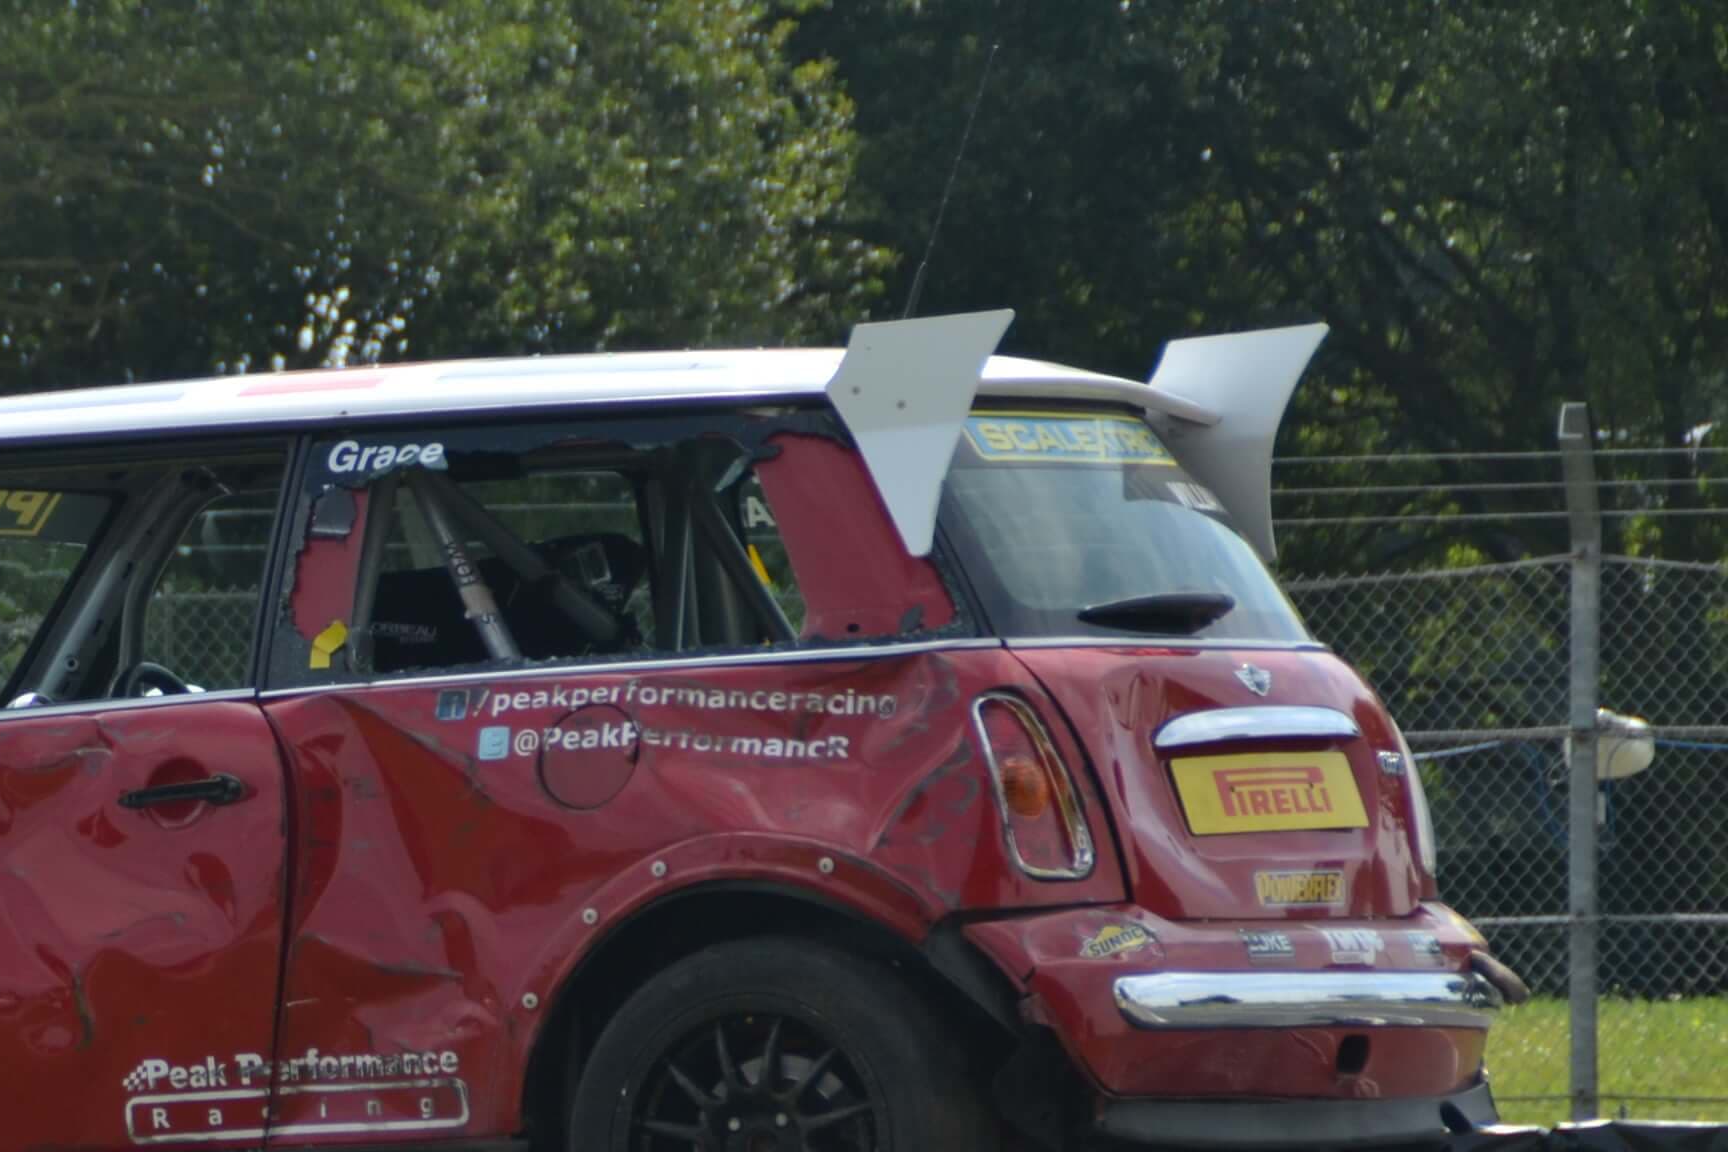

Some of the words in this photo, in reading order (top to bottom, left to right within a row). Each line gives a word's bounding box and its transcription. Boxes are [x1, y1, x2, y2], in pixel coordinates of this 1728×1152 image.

[328, 440, 444, 473] Grace
[1212, 766, 1334, 817] PIRELLI
[143, 1056, 227, 1089] Peak
